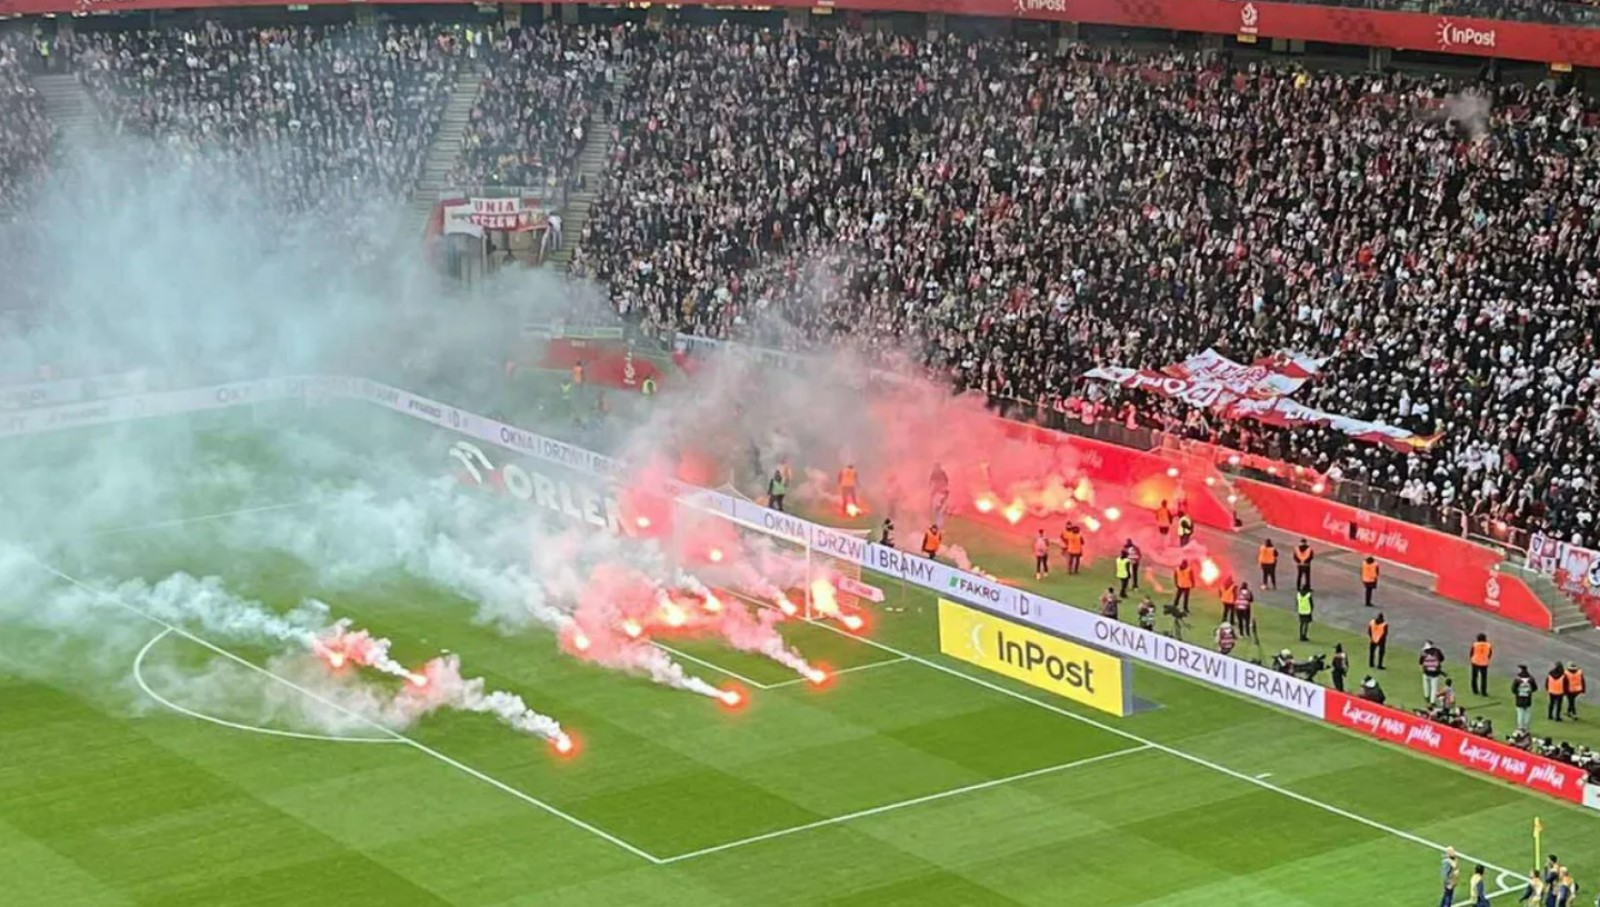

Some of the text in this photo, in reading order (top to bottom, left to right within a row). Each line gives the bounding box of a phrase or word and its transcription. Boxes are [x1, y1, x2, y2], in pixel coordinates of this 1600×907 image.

[1452, 27, 1495, 47] InPost
[475, 200, 515, 213] UNIA
[500, 427, 534, 450] OKNA
[764, 511, 935, 582] OKNA DRZWI BRAMY
[960, 578, 1000, 602] FAKRO
[998, 630, 1094, 694] InPost
[1095, 621, 1317, 708] OKNA DRZWI BRAMY
[1342, 700, 1442, 749] Łączy nas piłka
[1459, 737, 1565, 790] Łączy nas piłka
